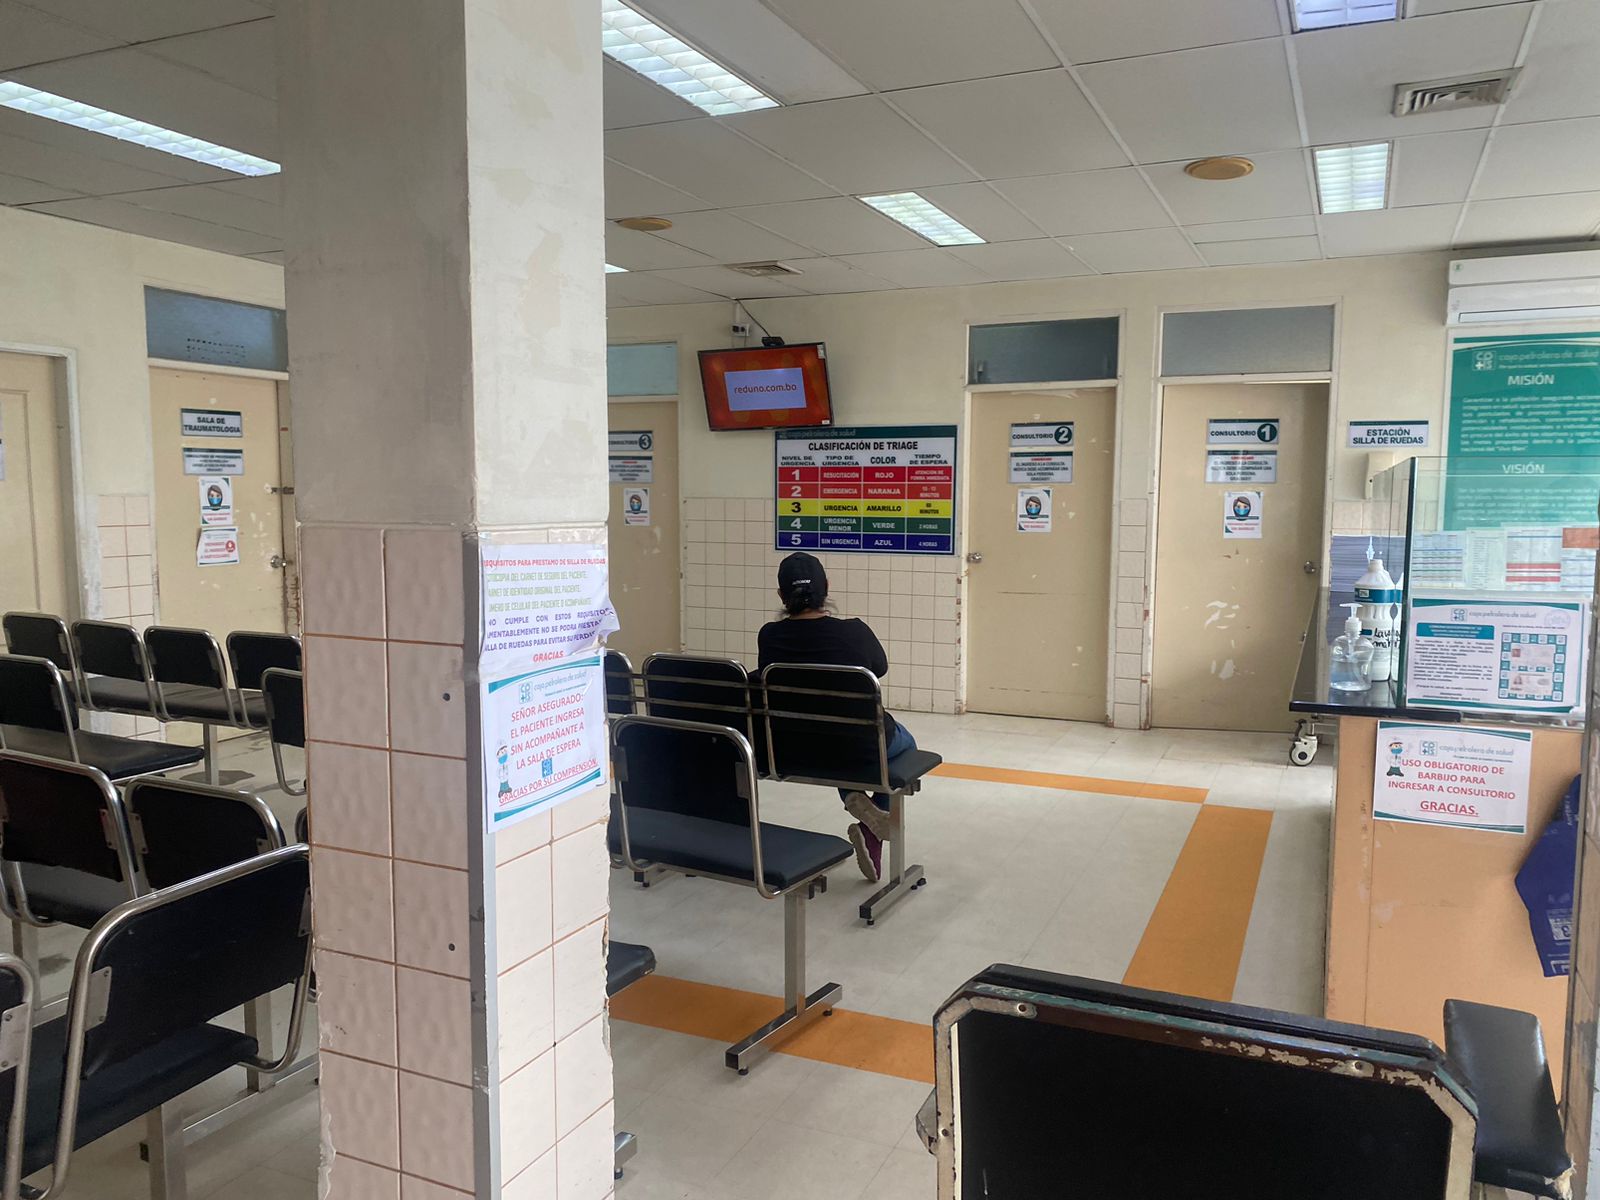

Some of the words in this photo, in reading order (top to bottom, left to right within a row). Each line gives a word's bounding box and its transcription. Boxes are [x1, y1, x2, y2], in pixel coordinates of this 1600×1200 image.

[1508, 372, 1554, 386] MISIÓN
[734, 384, 797, 394] reduno.com.bo
[184, 424, 240, 433] TRAUMATOLOGIA
[1261, 425, 1271, 440] 1
[1366, 427, 1410, 436] ESTACIÓN
[1058, 428, 1069, 442] 2
[642, 436, 648, 447] 3
[808, 440, 872, 451] CLASIFICACIÓN
[873, 442, 885, 450] DE
[887, 442, 918, 450] TRIAGE
[1502, 463, 1544, 474] VISIÓN
[791, 470, 800, 480] 1
[791, 486, 801, 497] 2
[791, 502, 801, 513] 3
[791, 518, 801, 529] 4
[791, 534, 801, 545] 5
[505, 616, 528, 625] CUMPLE
[509, 640, 532, 648] RUEDAS
[534, 638, 547, 646] PARA
[549, 636, 566, 644] EVITAR
[533, 650, 564, 662] GRACIAS
[511, 706, 536, 722] SEÑOR
[538, 694, 584, 714] ASEGURADO:
[511, 728, 519, 738] EL
[520, 716, 554, 736] PACIENTE
[556, 707, 585, 724] INGRESA
[511, 742, 523, 756] SIN
[525, 726, 577, 750] ACOMPAÑANTE
[578, 724, 584, 732] A
[517, 760, 526, 770] LA
[527, 752, 544, 767] SALA
[546, 748, 555, 759] DE
[557, 740, 581, 755] ESPERA
[1402, 759, 1421, 767] USO
[1424, 760, 1488, 773] OBLIGATORIO
[1492, 766, 1504, 774] DE
[1418, 772, 1457, 782] BARBIJO
[1460, 776, 1485, 784] PARA
[499, 787, 528, 804] GRACIAS
[529, 780, 542, 793] POR
[544, 777, 552, 788] SU
[1388, 781, 1435, 792] INGRESAR
[1447, 786, 1515, 800] CONSULTORIO
[1420, 800, 1479, 816] GRACIAS.
